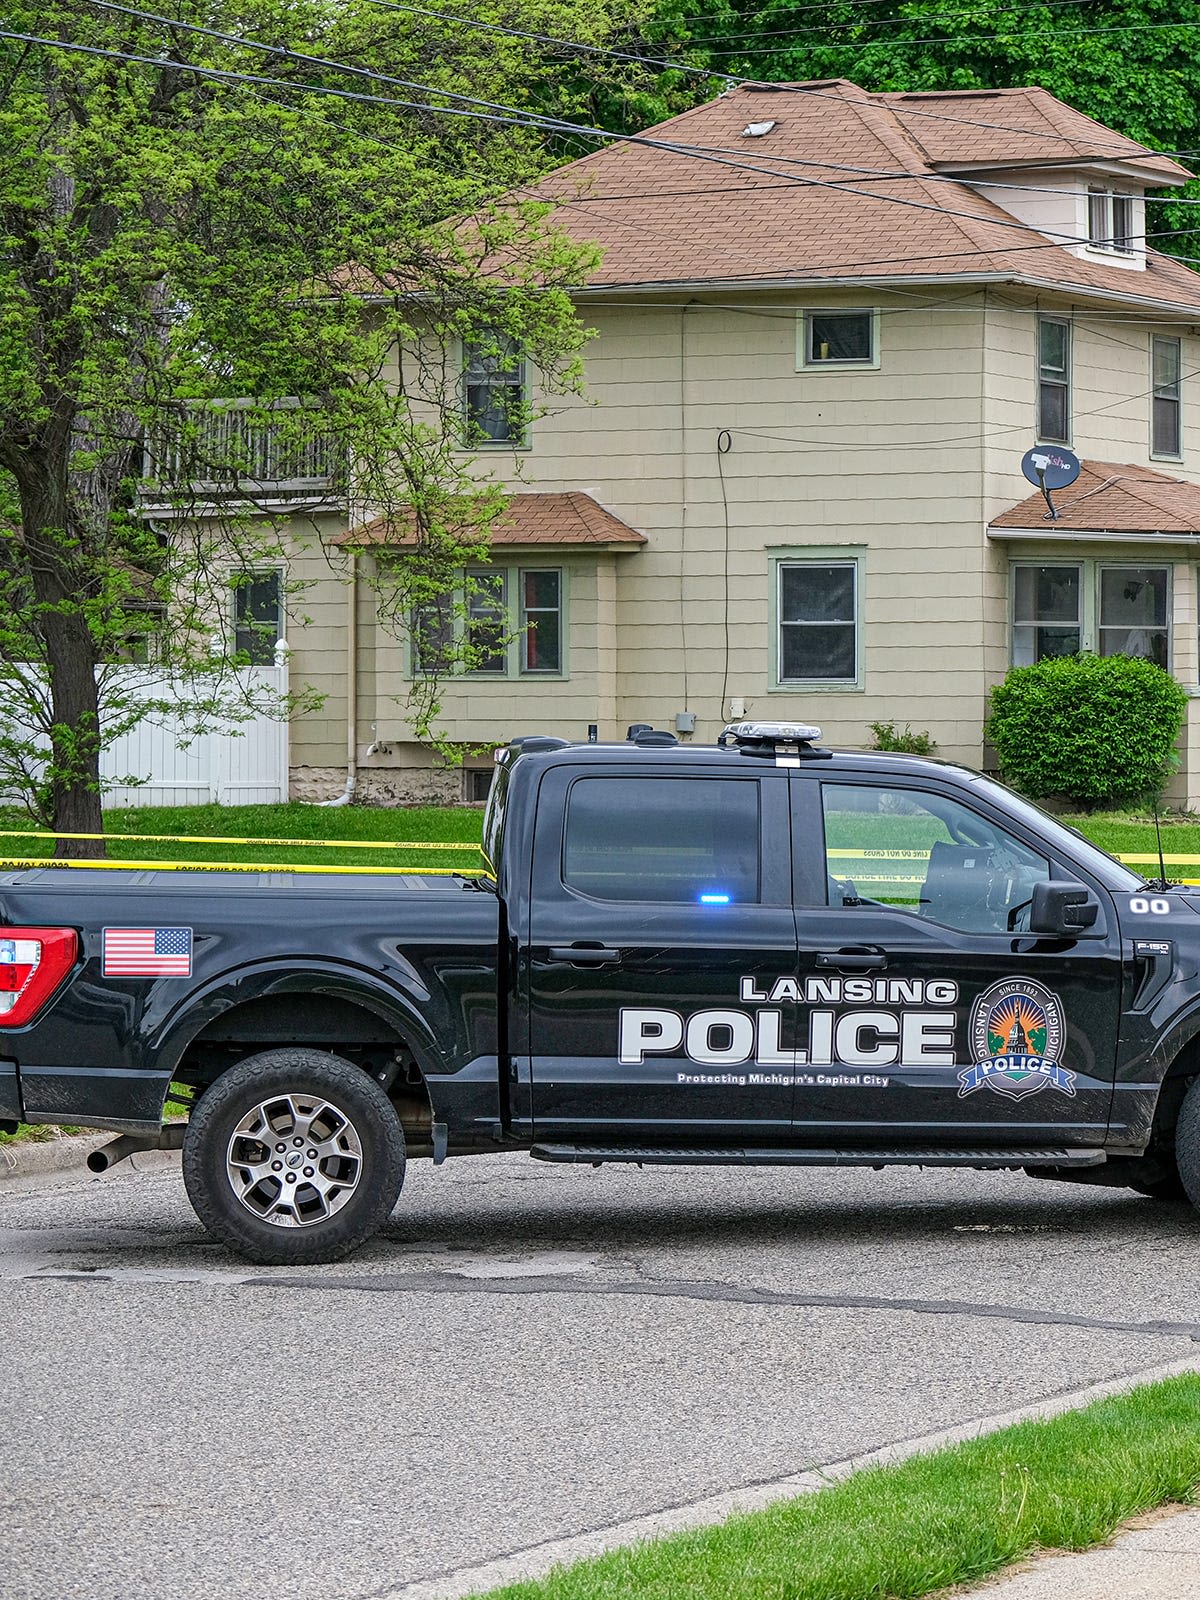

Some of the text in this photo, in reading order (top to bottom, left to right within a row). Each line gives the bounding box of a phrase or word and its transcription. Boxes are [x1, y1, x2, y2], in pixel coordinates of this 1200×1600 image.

[1130, 897, 1170, 915] 00
[1137, 943, 1169, 951] F-150
[742, 977, 956, 1002] LANSING
[998, 984, 1039, 997] SINCE 1893
[619, 1009, 956, 1066] POLICE
[975, 1002, 990, 1058] LANSING
[1045, 1001, 1060, 1058] MICHIGAN
[981, 1057, 1053, 1075] POLICE
[677, 1073, 890, 1087] Protecting Michigan's Capital City
